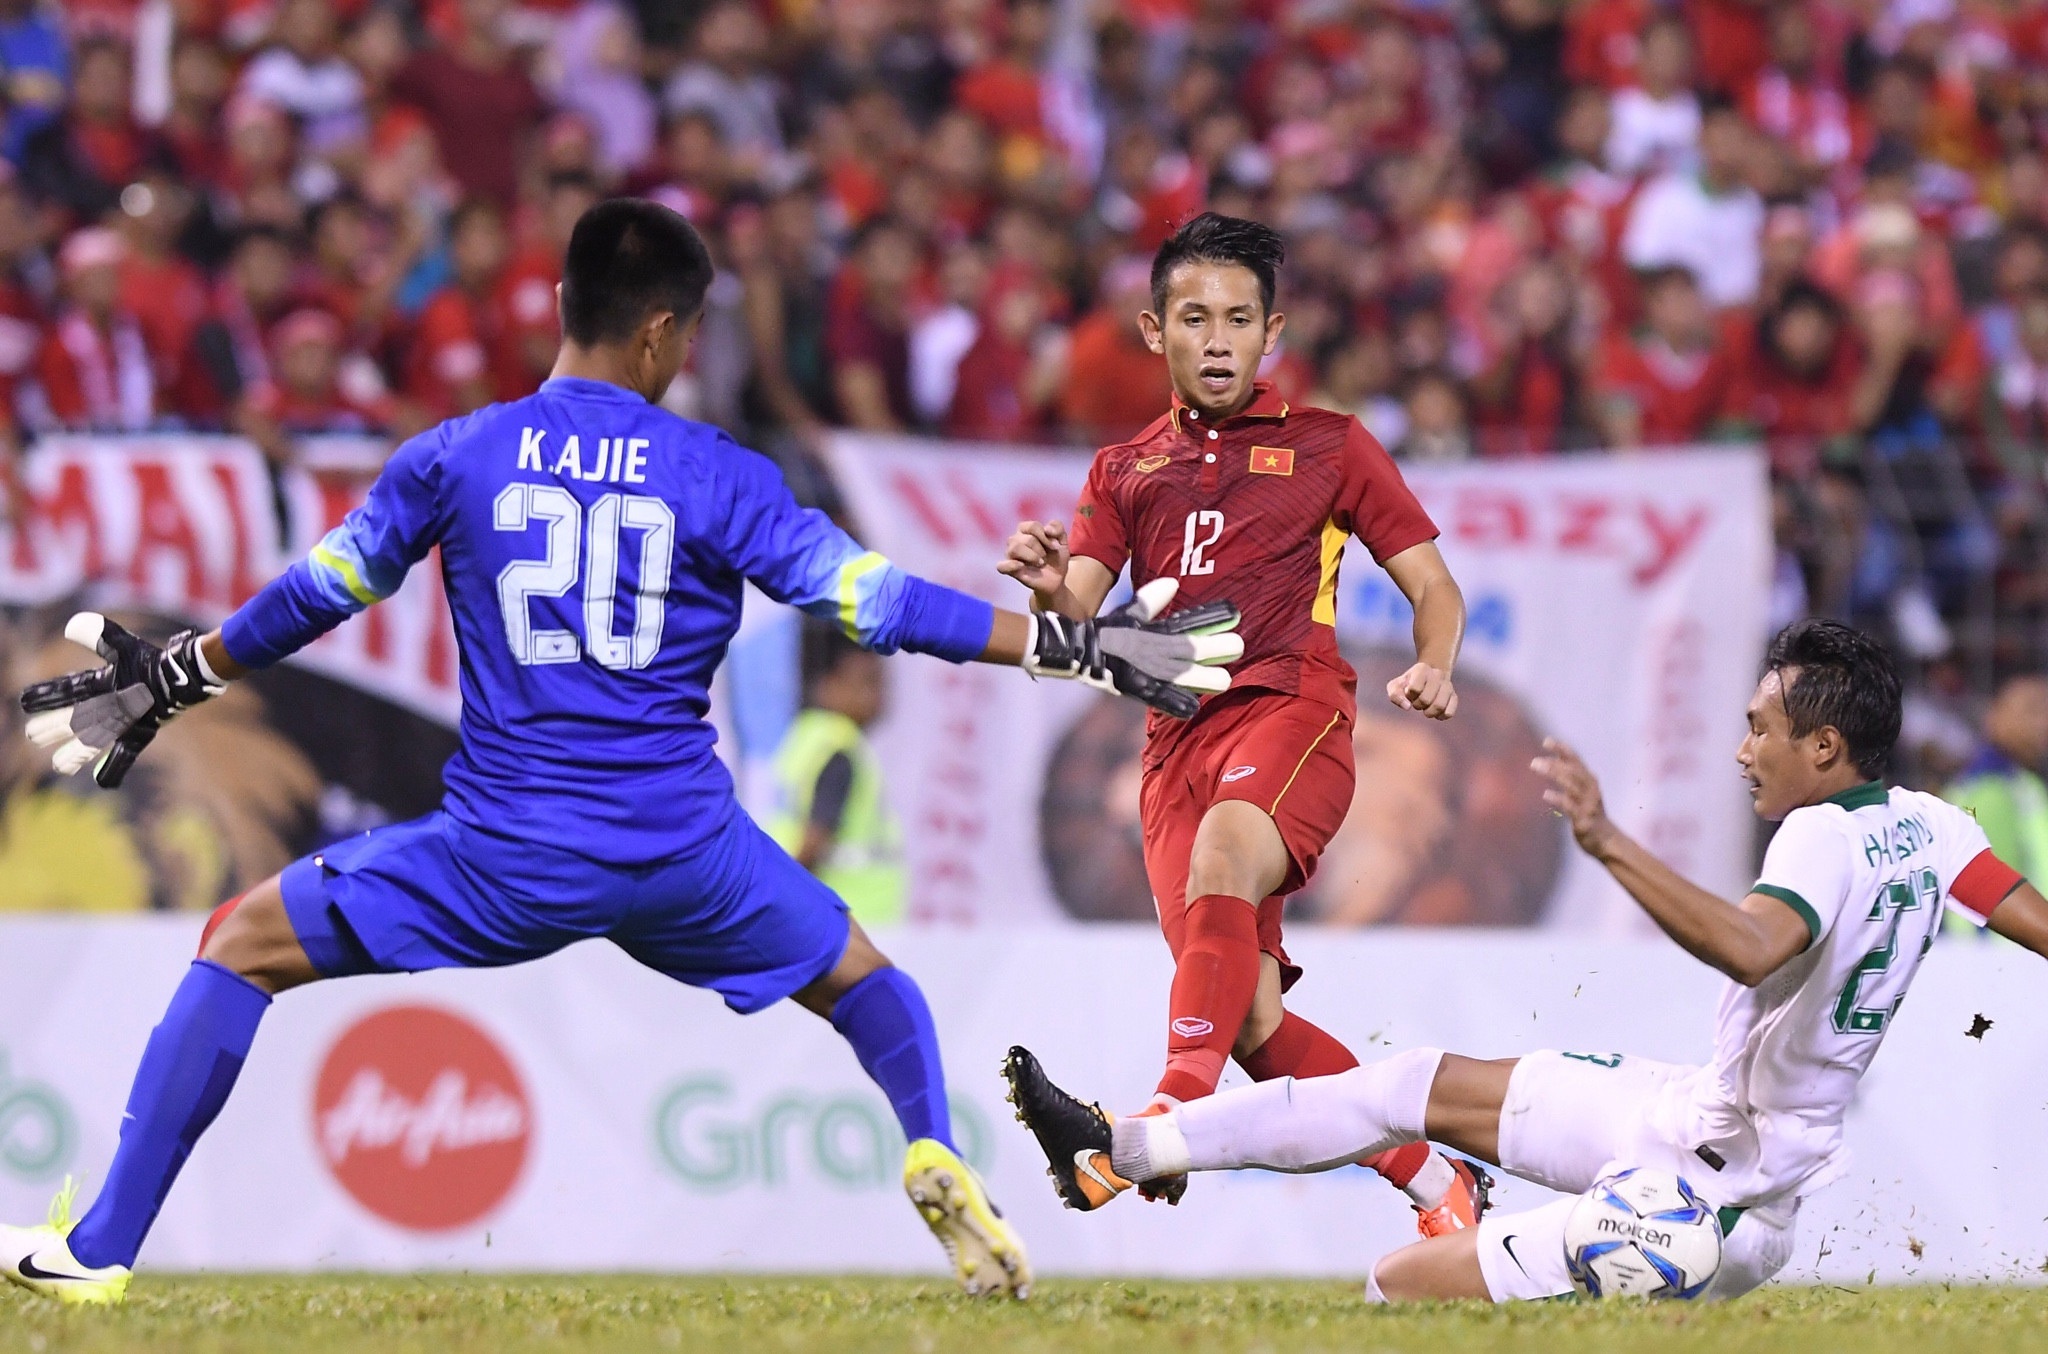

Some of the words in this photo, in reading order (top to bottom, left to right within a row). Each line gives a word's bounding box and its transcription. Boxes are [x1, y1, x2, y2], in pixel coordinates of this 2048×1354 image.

[517, 427, 650, 483] K.AJIE
[493, 482, 676, 670] 20
[1180, 510, 1225, 576] 12
[324, 1066, 524, 1167] AirAsia
[1597, 1217, 1672, 1249] molten
